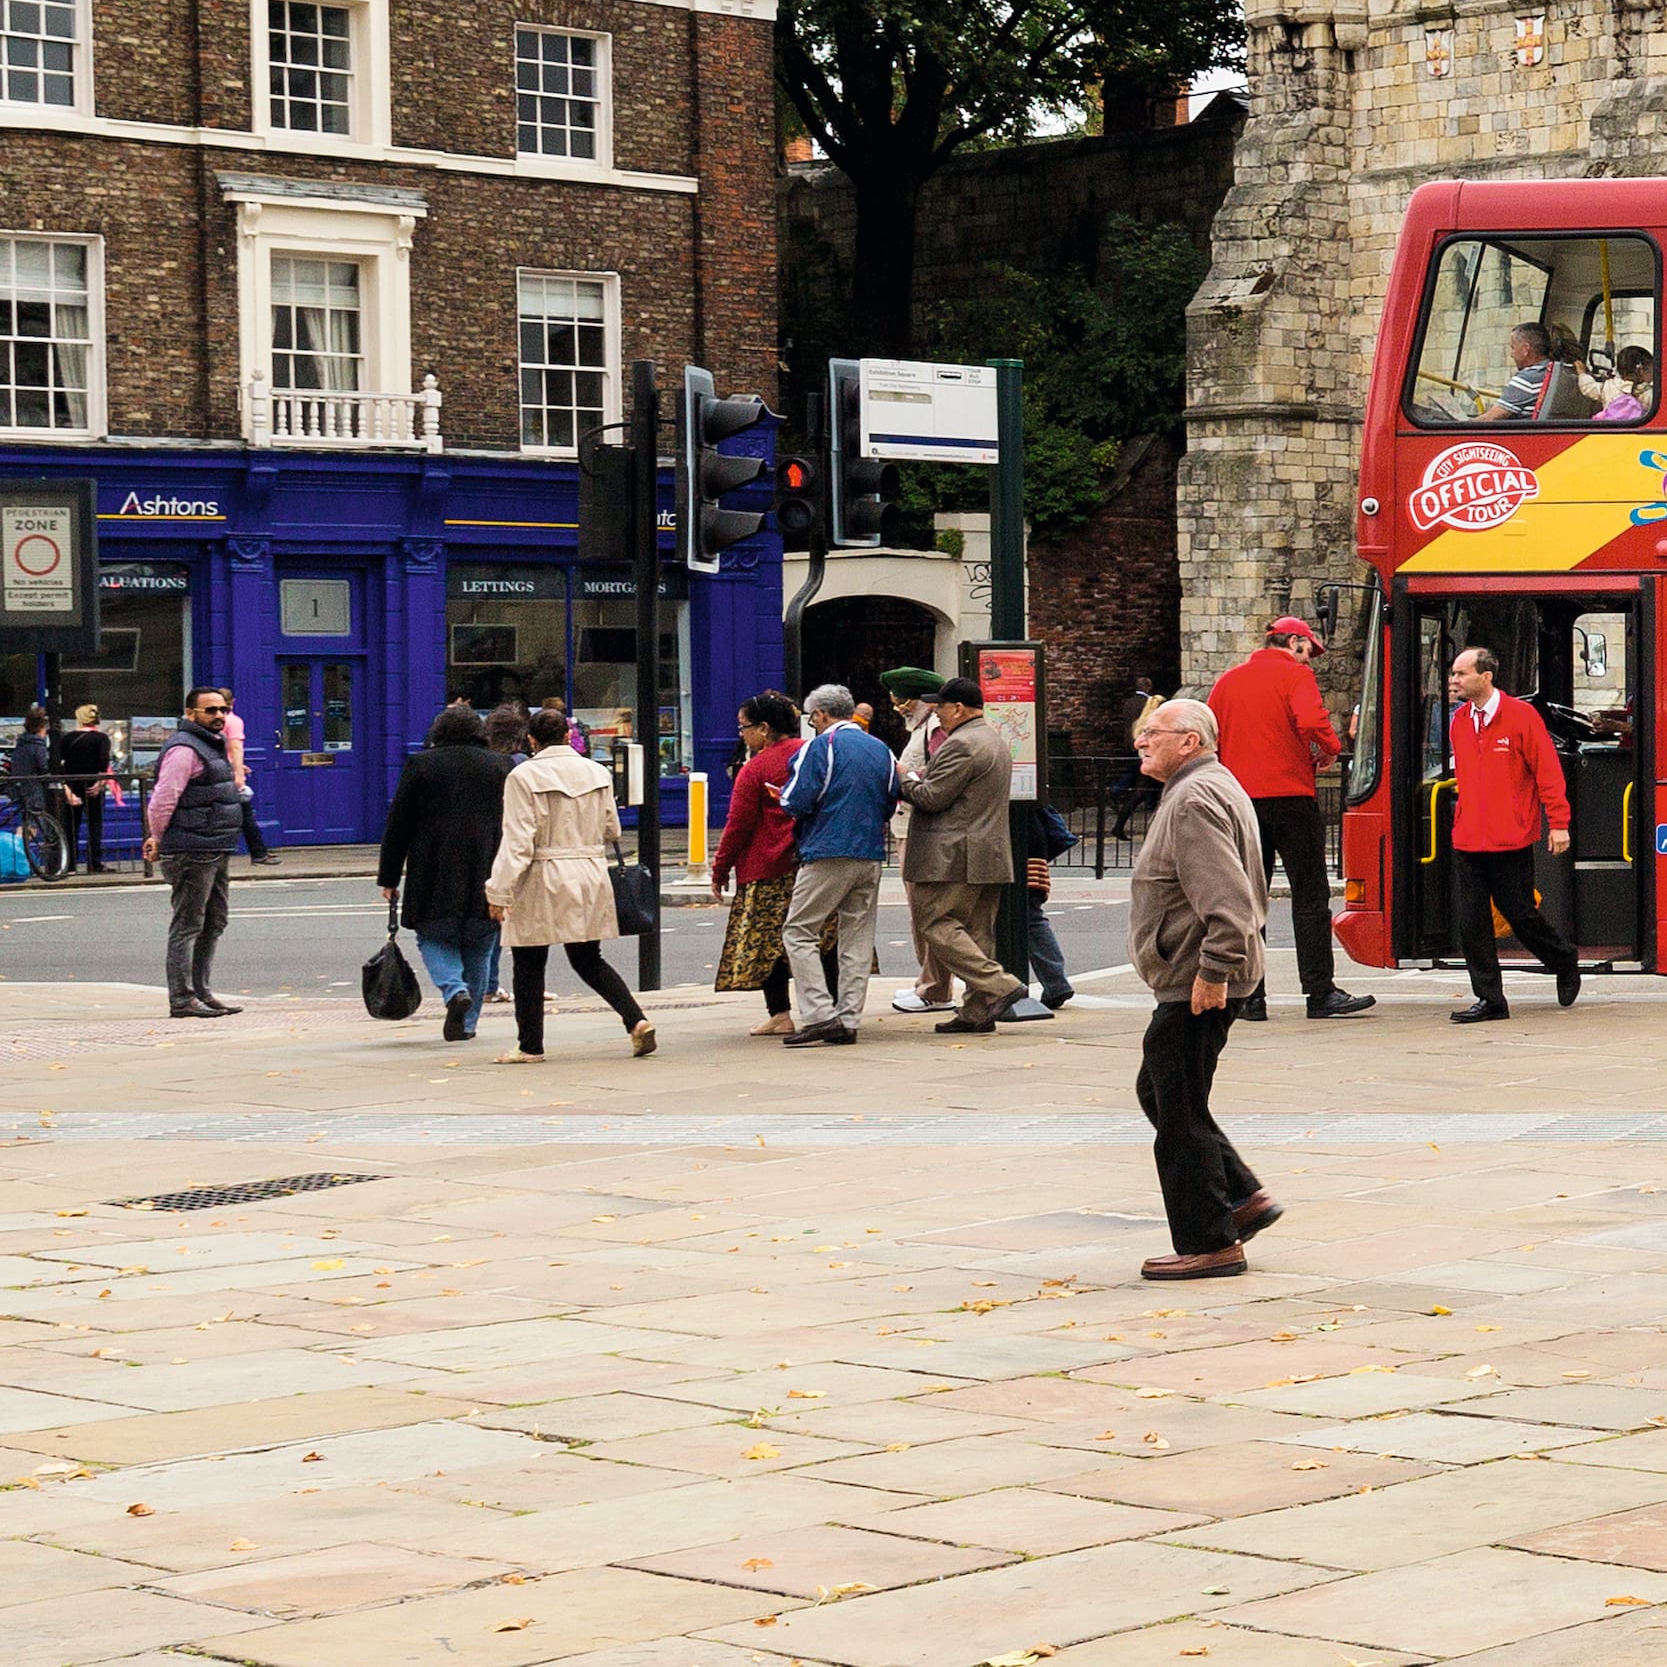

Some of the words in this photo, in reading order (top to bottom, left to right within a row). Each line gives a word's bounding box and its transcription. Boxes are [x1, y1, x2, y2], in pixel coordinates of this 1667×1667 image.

[1437, 459, 1454, 478] CITY
[1453, 446, 1511, 467] SIGHTSEEING
[119, 491, 219, 516] Ashtons
[1420, 471, 1535, 518] OFFICIAL
[6, 509, 67, 517] PEDESTRIAN
[1467, 496, 1514, 522] TOUR
[15, 519, 58, 531] ZONE
[99, 577, 188, 589] ALUATIONS
[462, 581, 535, 593] LETTINGS
[312, 598, 319, 617] 1
